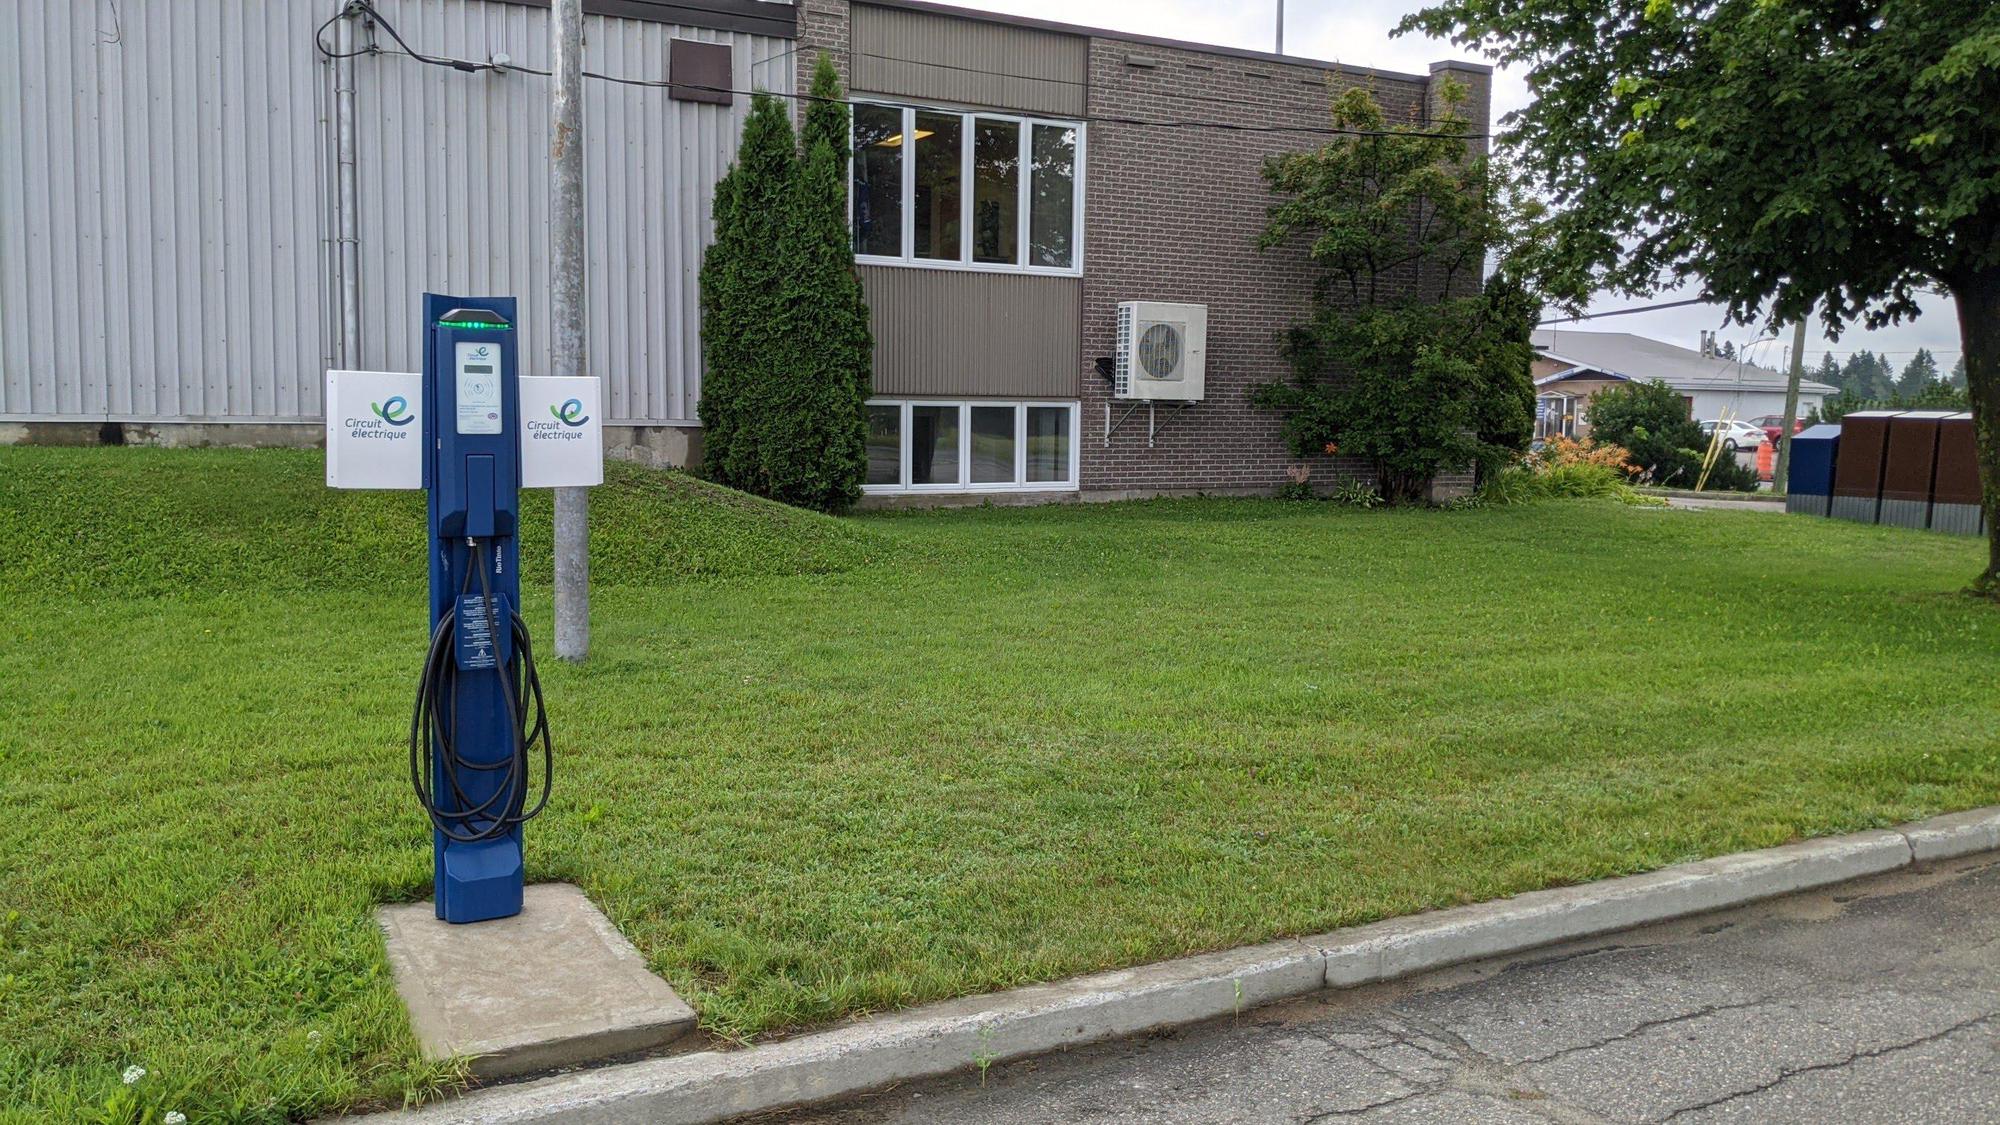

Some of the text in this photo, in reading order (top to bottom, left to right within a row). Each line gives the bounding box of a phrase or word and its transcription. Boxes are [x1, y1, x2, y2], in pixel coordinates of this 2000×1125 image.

[345, 418, 382, 428] Circuit
[527, 420, 561, 430] Circuit
[351, 428, 407, 441] électrique
[533, 430, 583, 441] électrique
